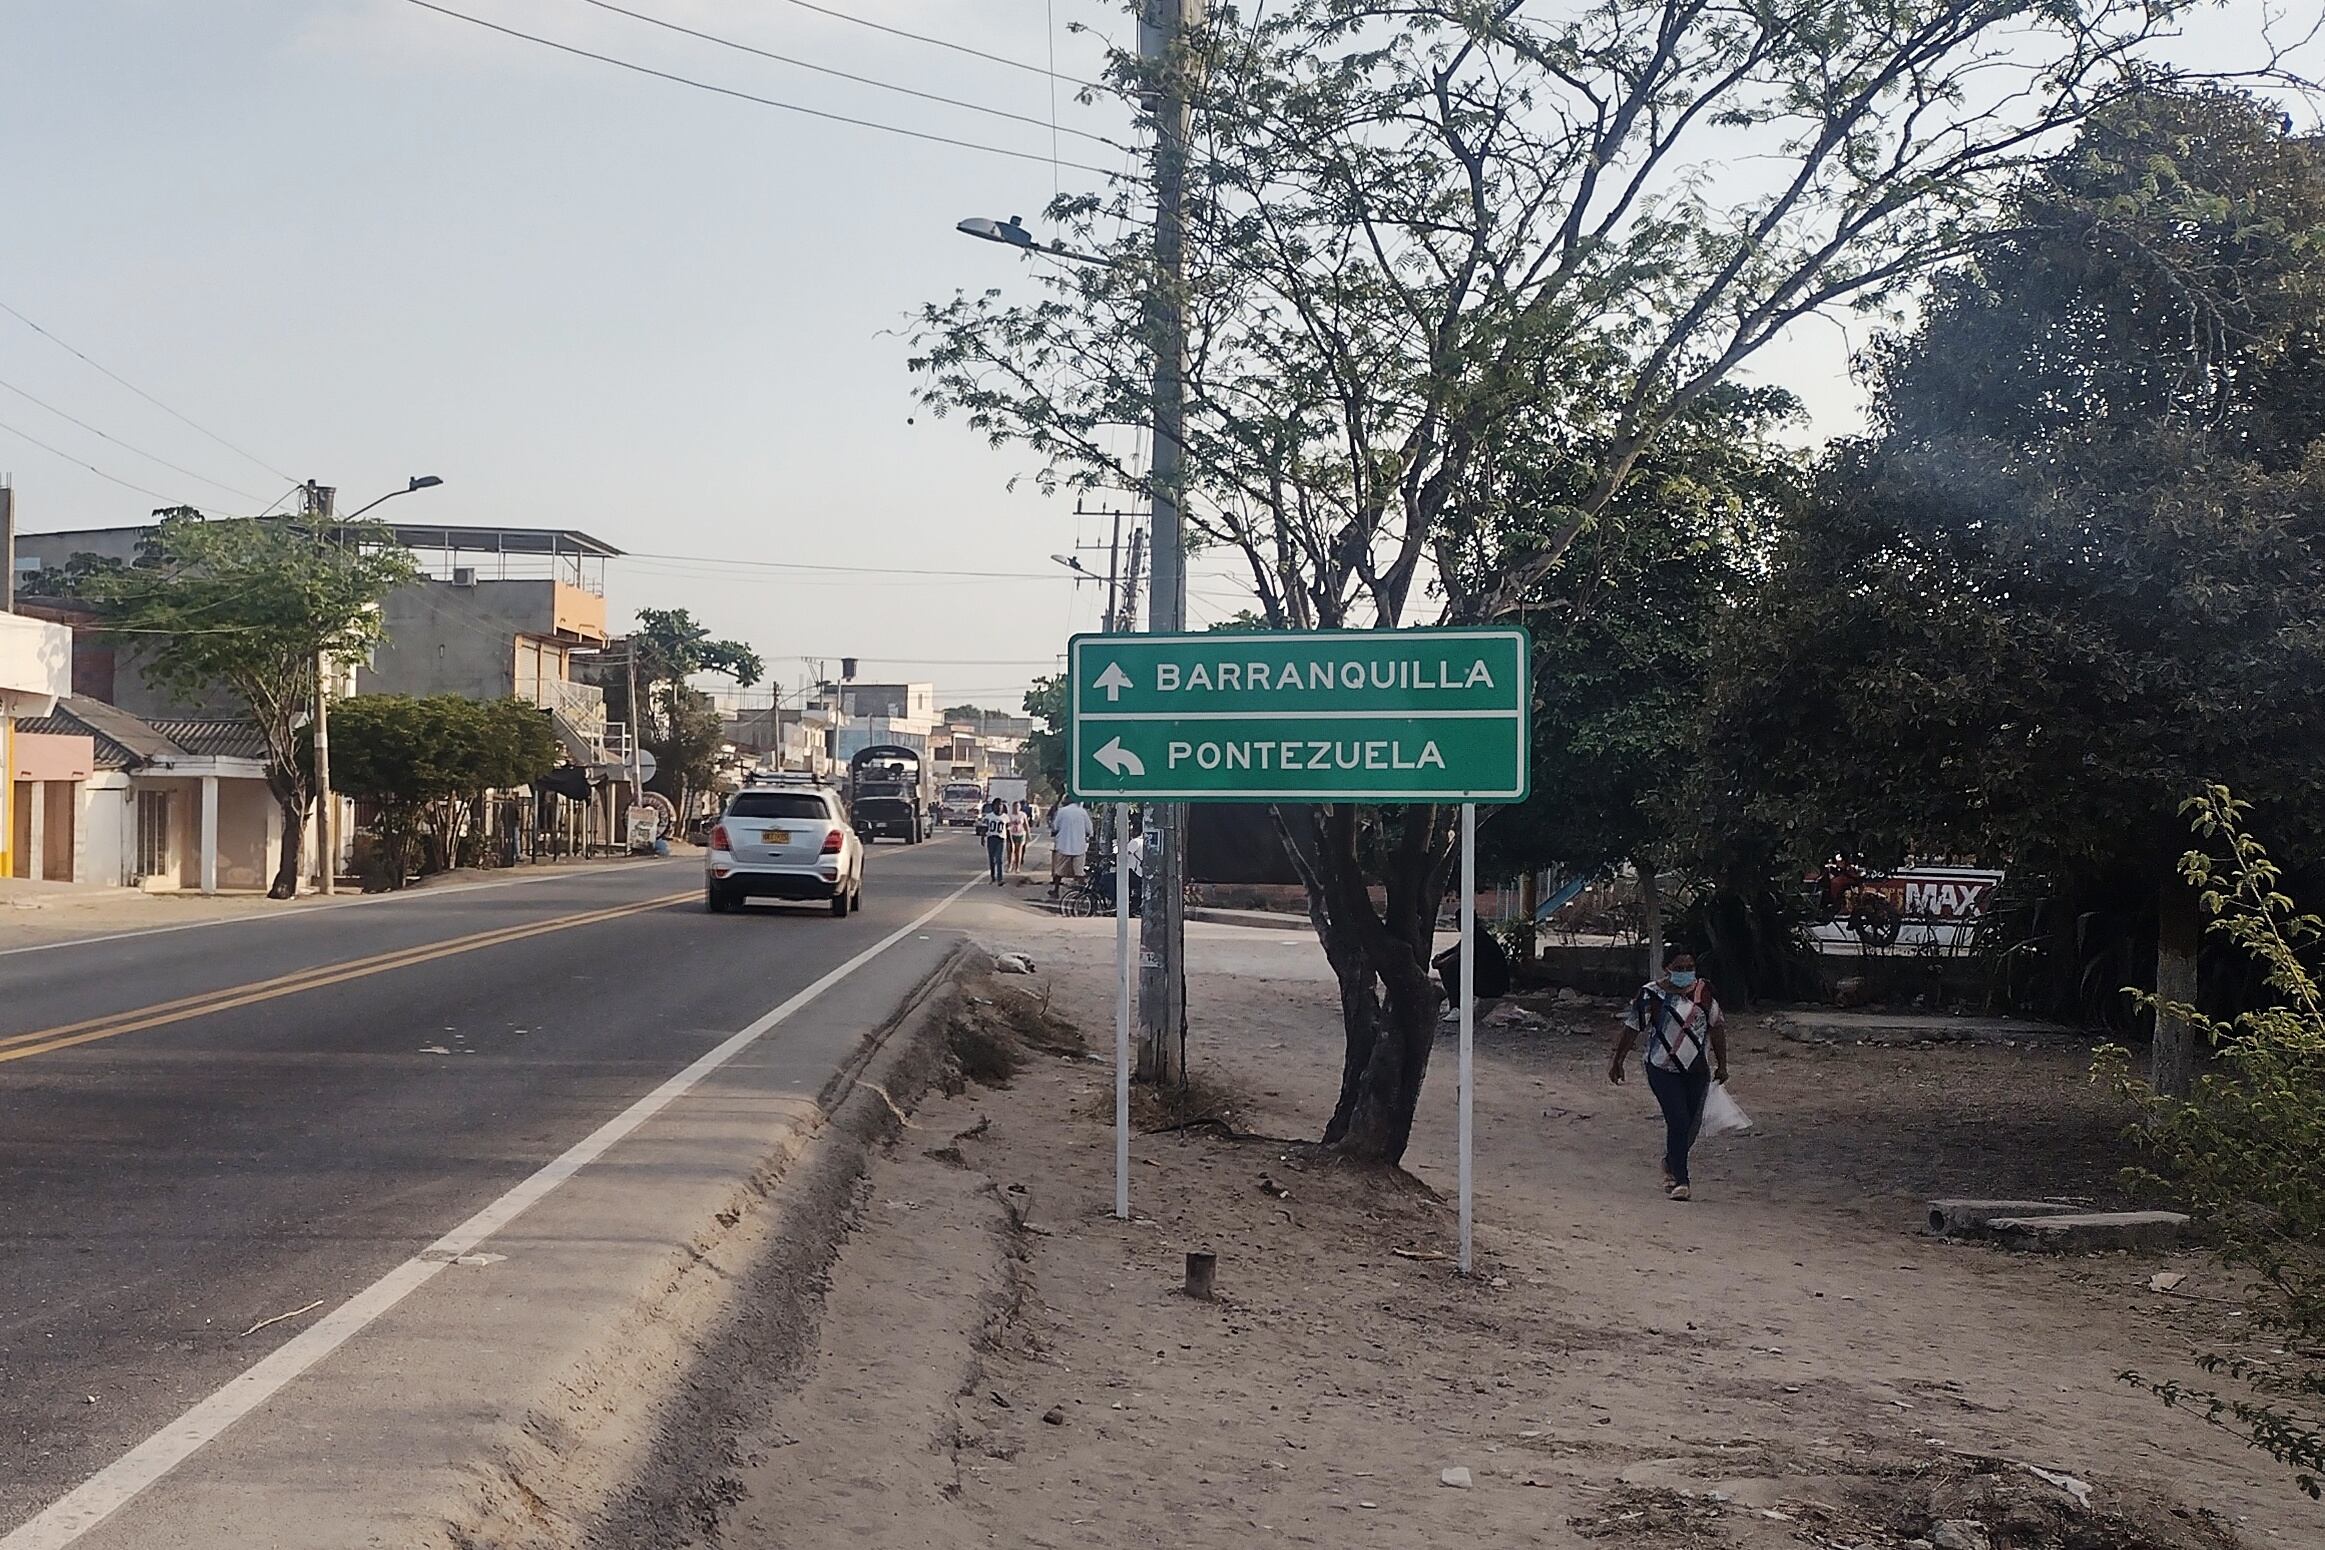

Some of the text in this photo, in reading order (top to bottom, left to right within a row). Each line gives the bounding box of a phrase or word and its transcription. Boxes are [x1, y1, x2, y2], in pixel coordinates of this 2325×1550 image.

[1156, 660, 1494, 691] BARRANQUILLA
[1168, 741, 1446, 769] PONTEZUELA
[1905, 883, 1983, 917] MAX
